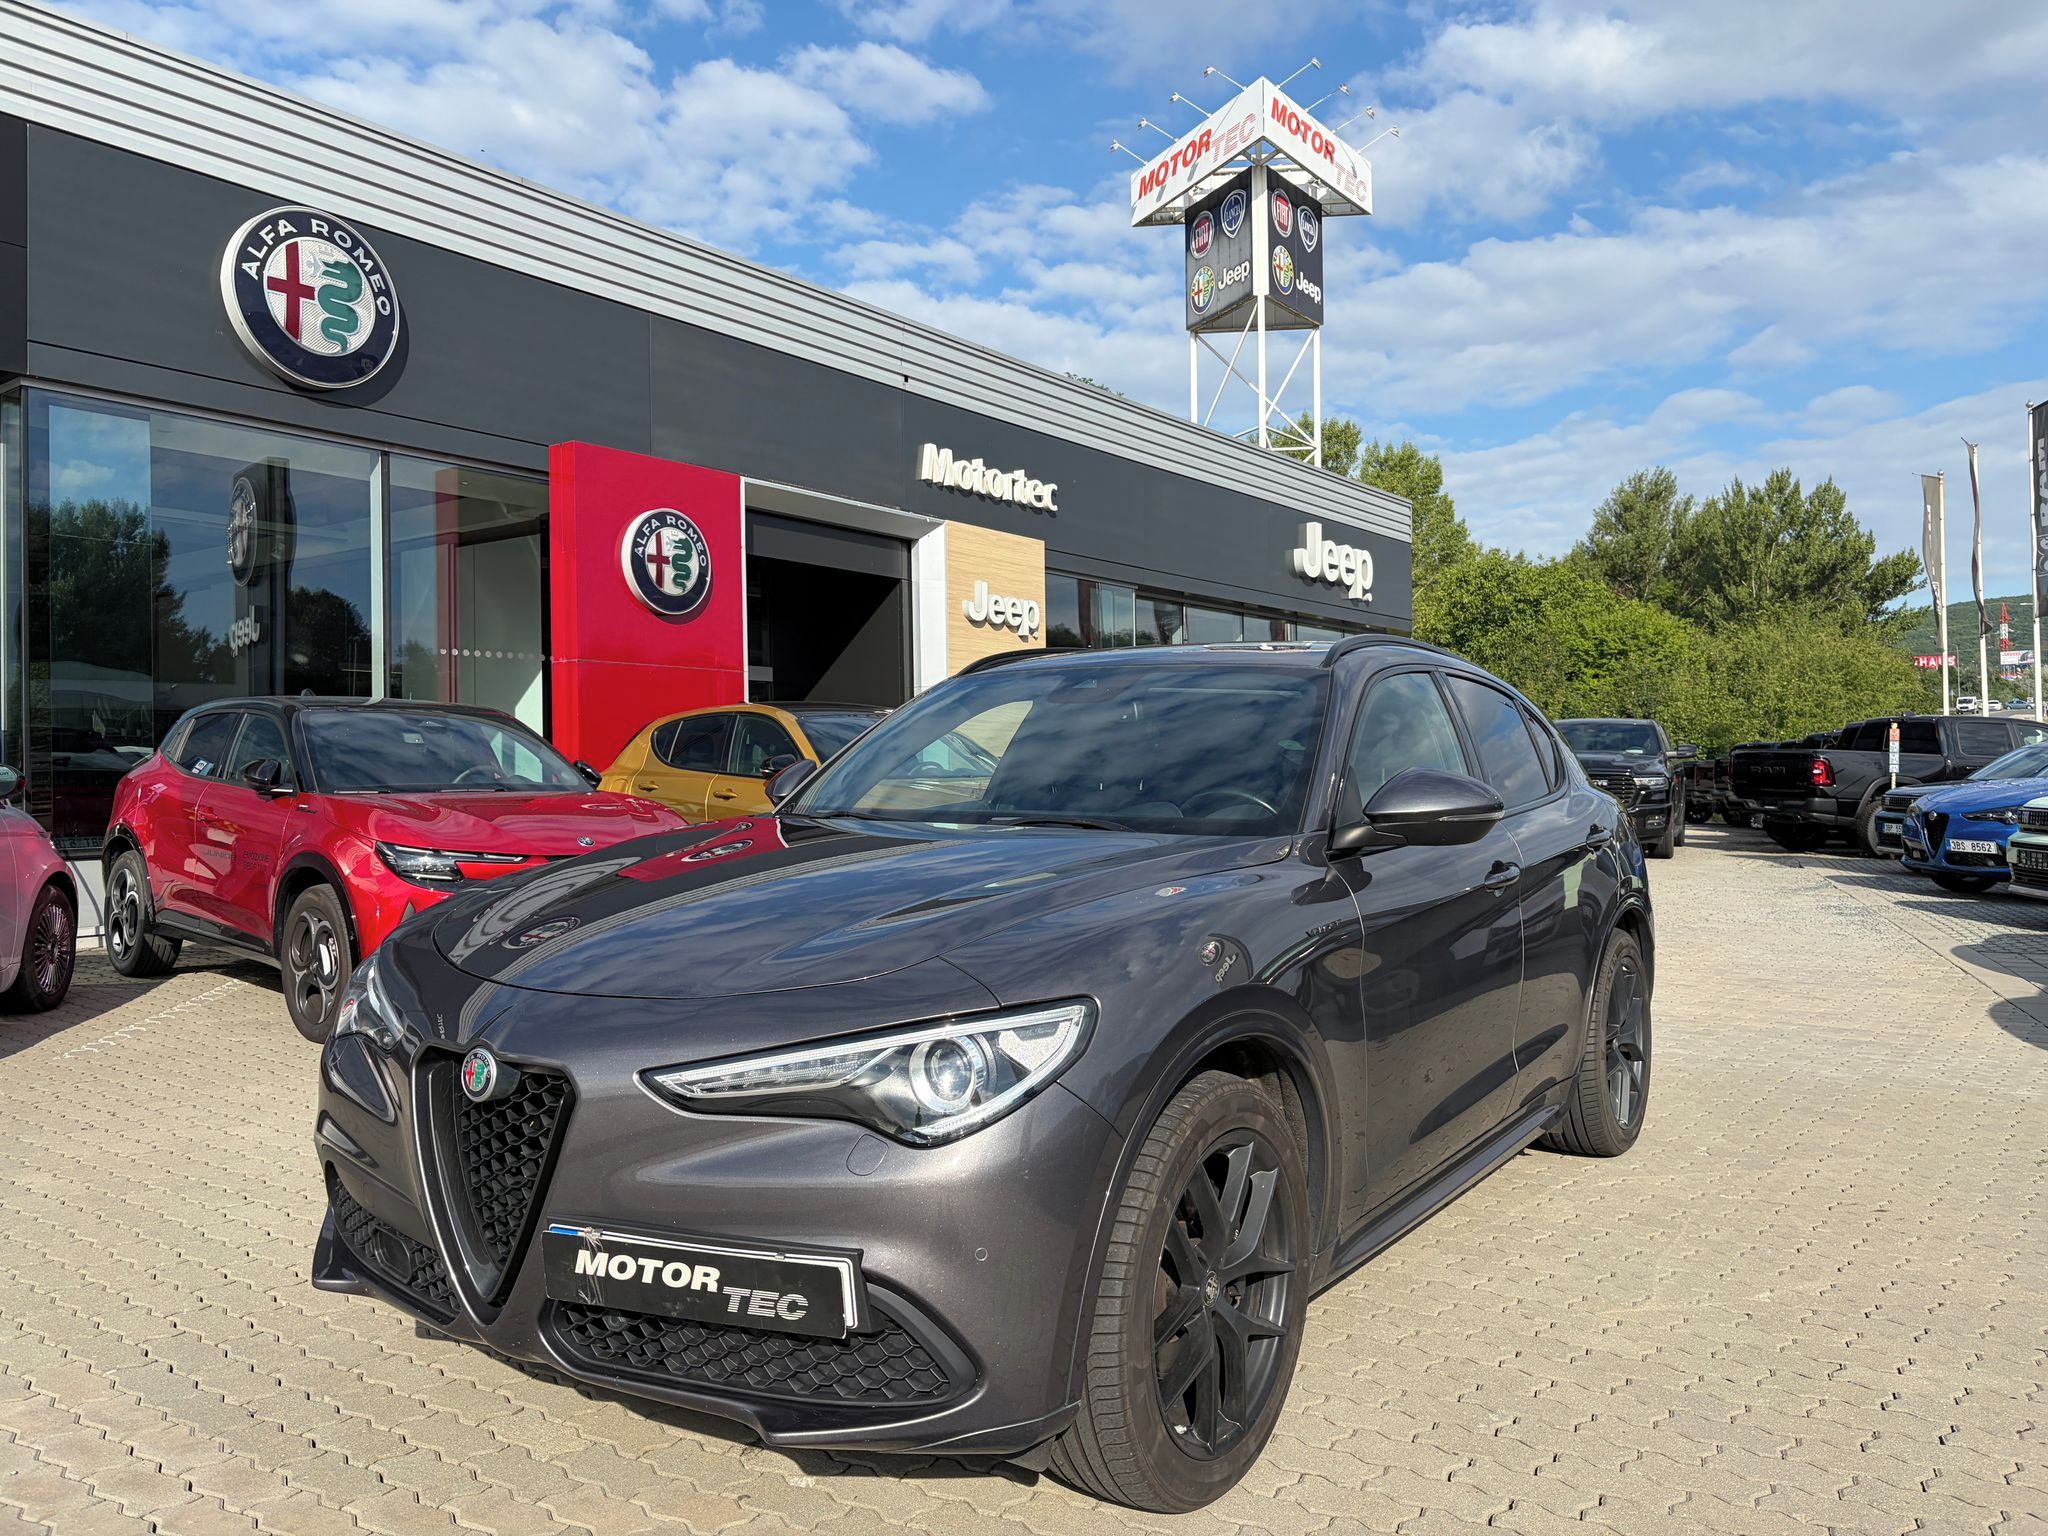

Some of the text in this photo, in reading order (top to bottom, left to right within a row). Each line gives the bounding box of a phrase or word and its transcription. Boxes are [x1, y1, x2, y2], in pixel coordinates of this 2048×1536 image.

[1138, 113, 1257, 200] MOTOR TEC
[1271, 96, 1367, 202] MOTOR TEC
[1195, 222, 1209, 249] FIAT
[1276, 200, 1289, 227] FIAT
[241, 218, 391, 316] ALFA ROMEO
[1218, 261, 1250, 290] Jeep
[1296, 271, 1321, 304] Jeep
[921, 443, 1058, 512] Motortec
[634, 515, 707, 567] ALFA ROMEO
[1293, 522, 1373, 601] Jeep
[962, 580, 1040, 637] Jeep
[1951, 840, 1992, 852] 3BS 8562
[575, 1249, 809, 1321] MOTOR TEC
